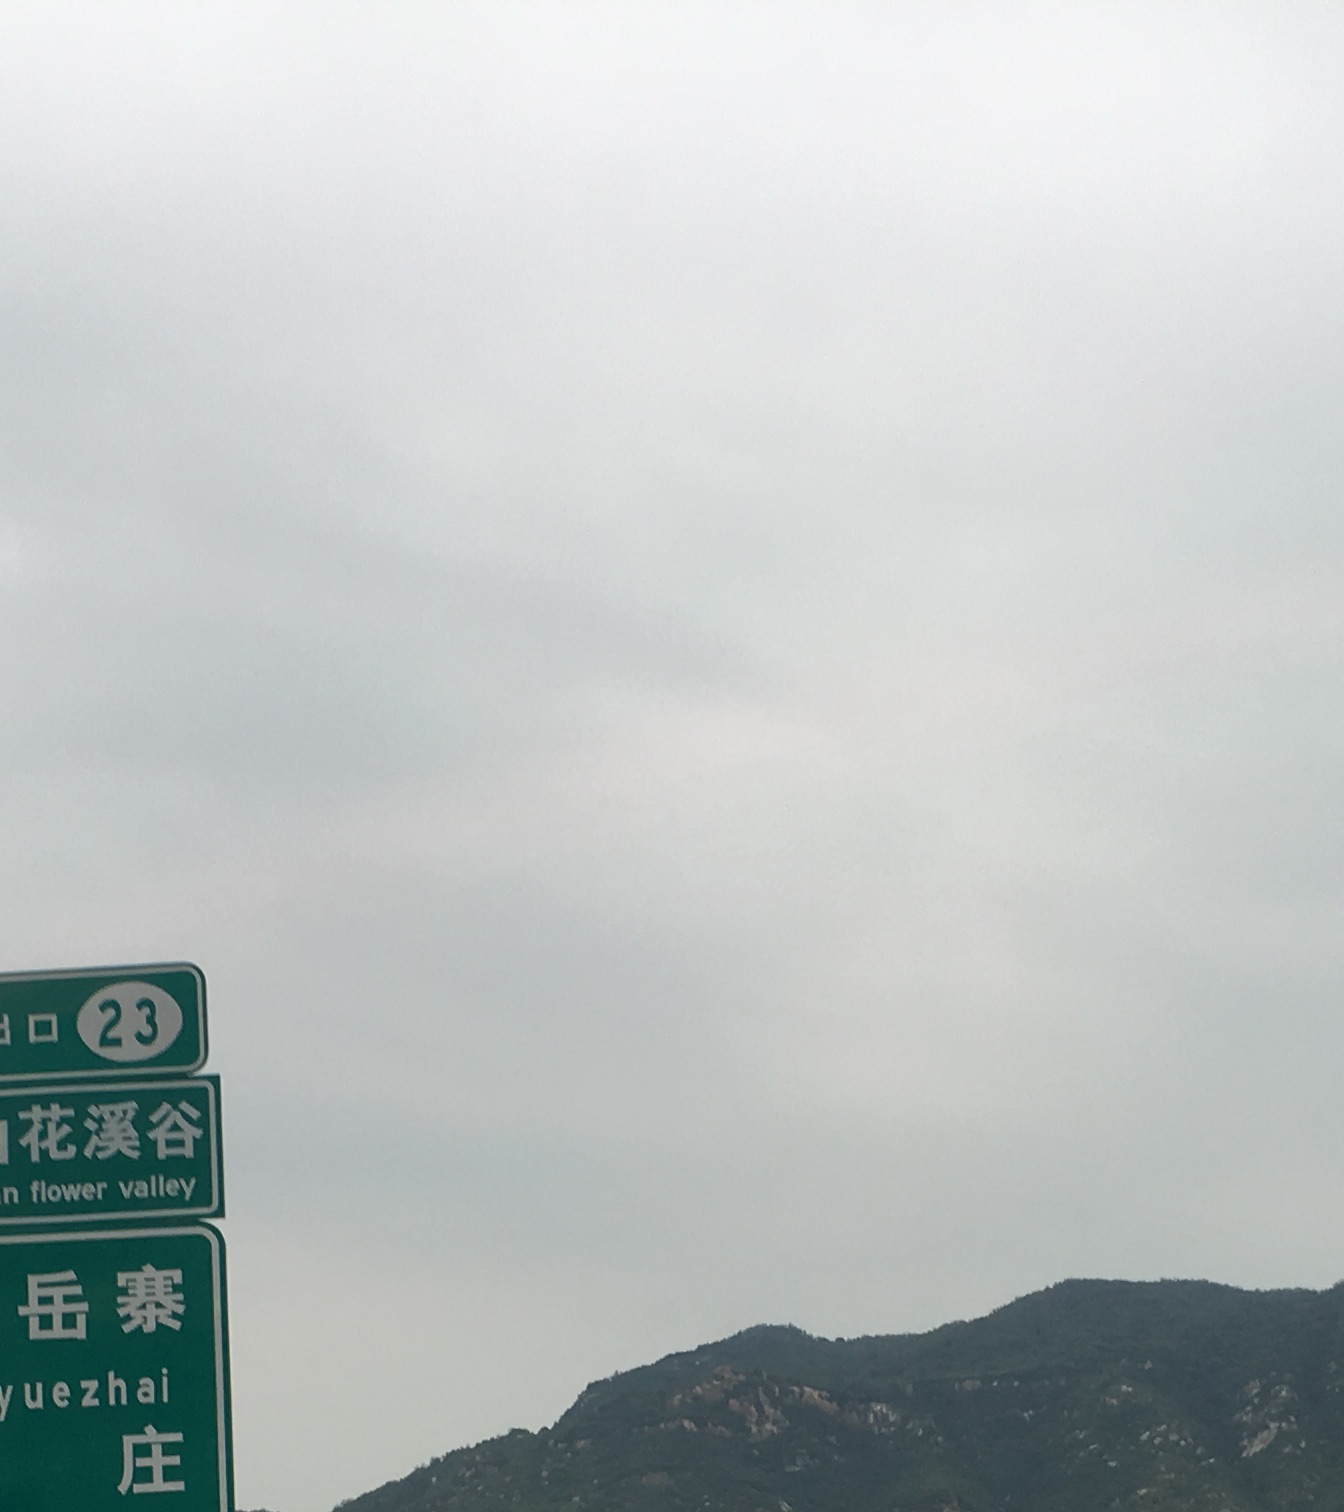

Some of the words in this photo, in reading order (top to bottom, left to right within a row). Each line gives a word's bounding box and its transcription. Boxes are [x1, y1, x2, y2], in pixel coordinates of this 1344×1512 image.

[99, 998, 158, 1048] 23
[30, 1179, 107, 1203] flower
[119, 1174, 196, 1201] valley
